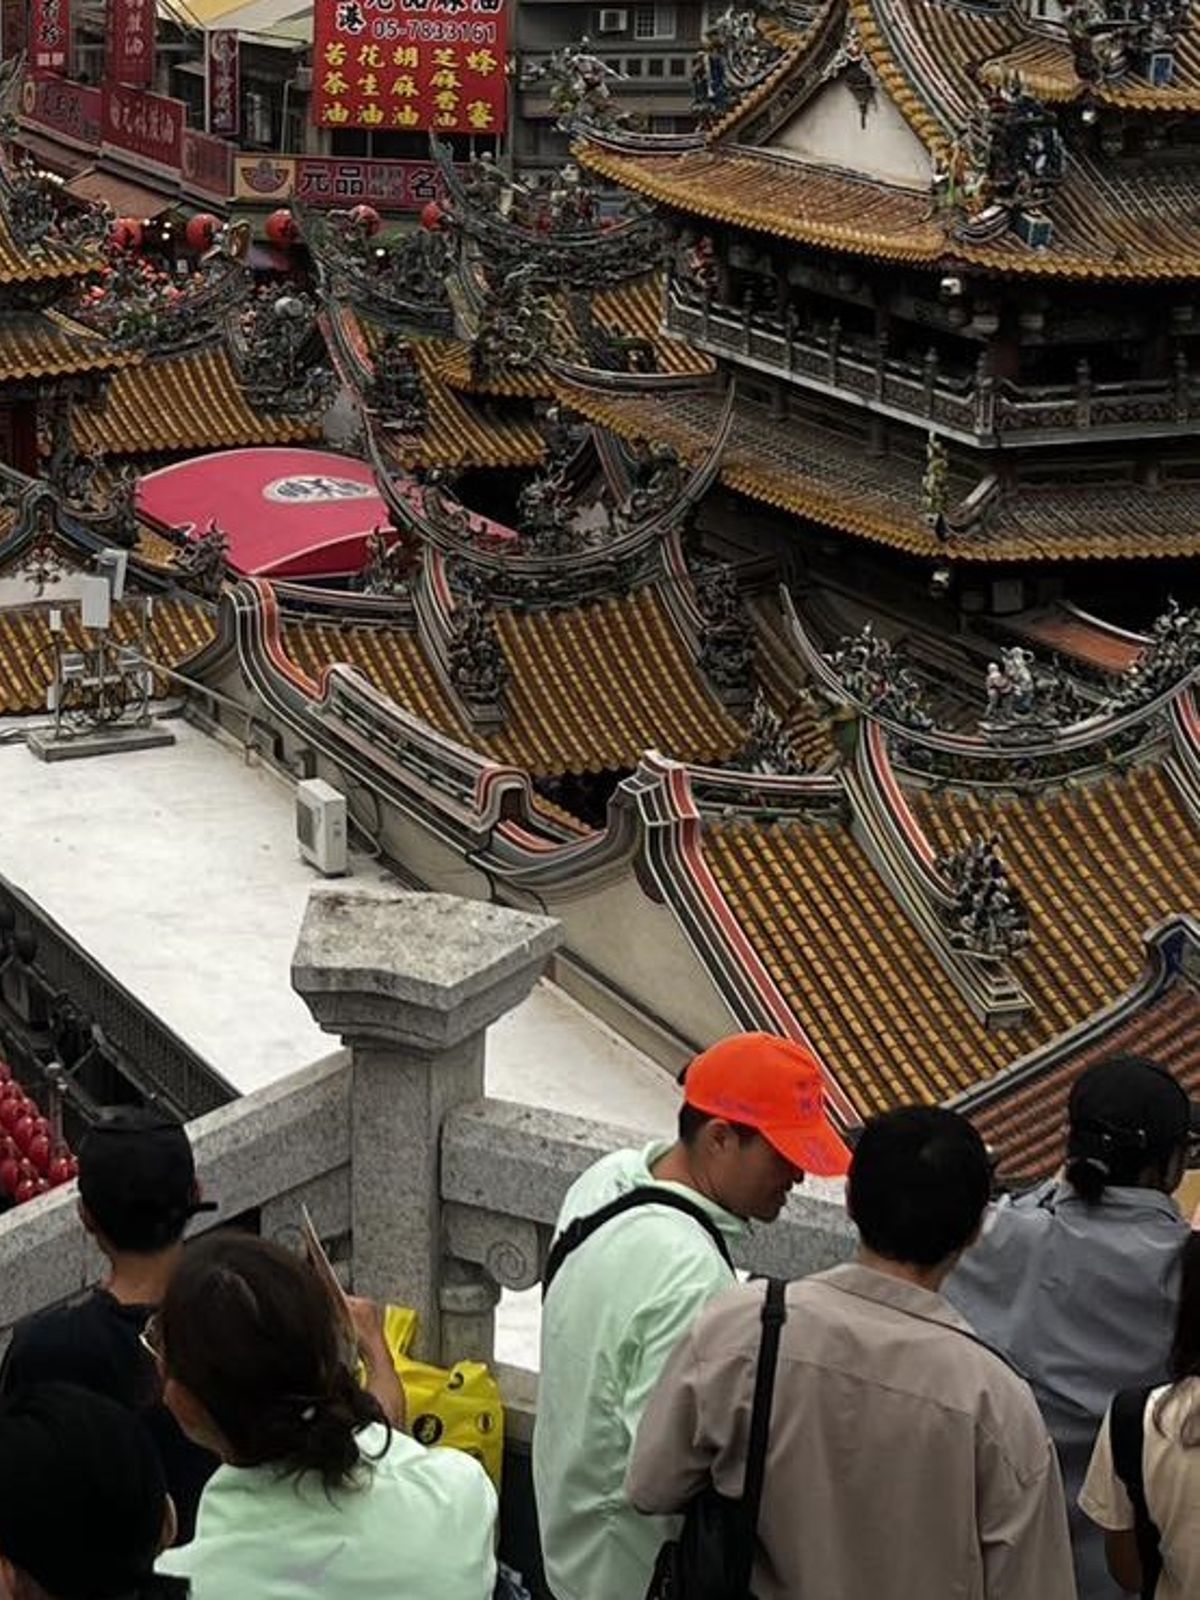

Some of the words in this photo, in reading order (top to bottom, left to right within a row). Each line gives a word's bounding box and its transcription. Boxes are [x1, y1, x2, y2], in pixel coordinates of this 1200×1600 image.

[322, 42, 349, 123] 苦茶油
[357, 44, 385, 125] 花生油
[392, 46, 420, 126] 胡麻油
[429, 49, 463, 128] 芝麻香油
[466, 50, 498, 129] 蜂蜜
[302, 164, 364, 196] 元品
